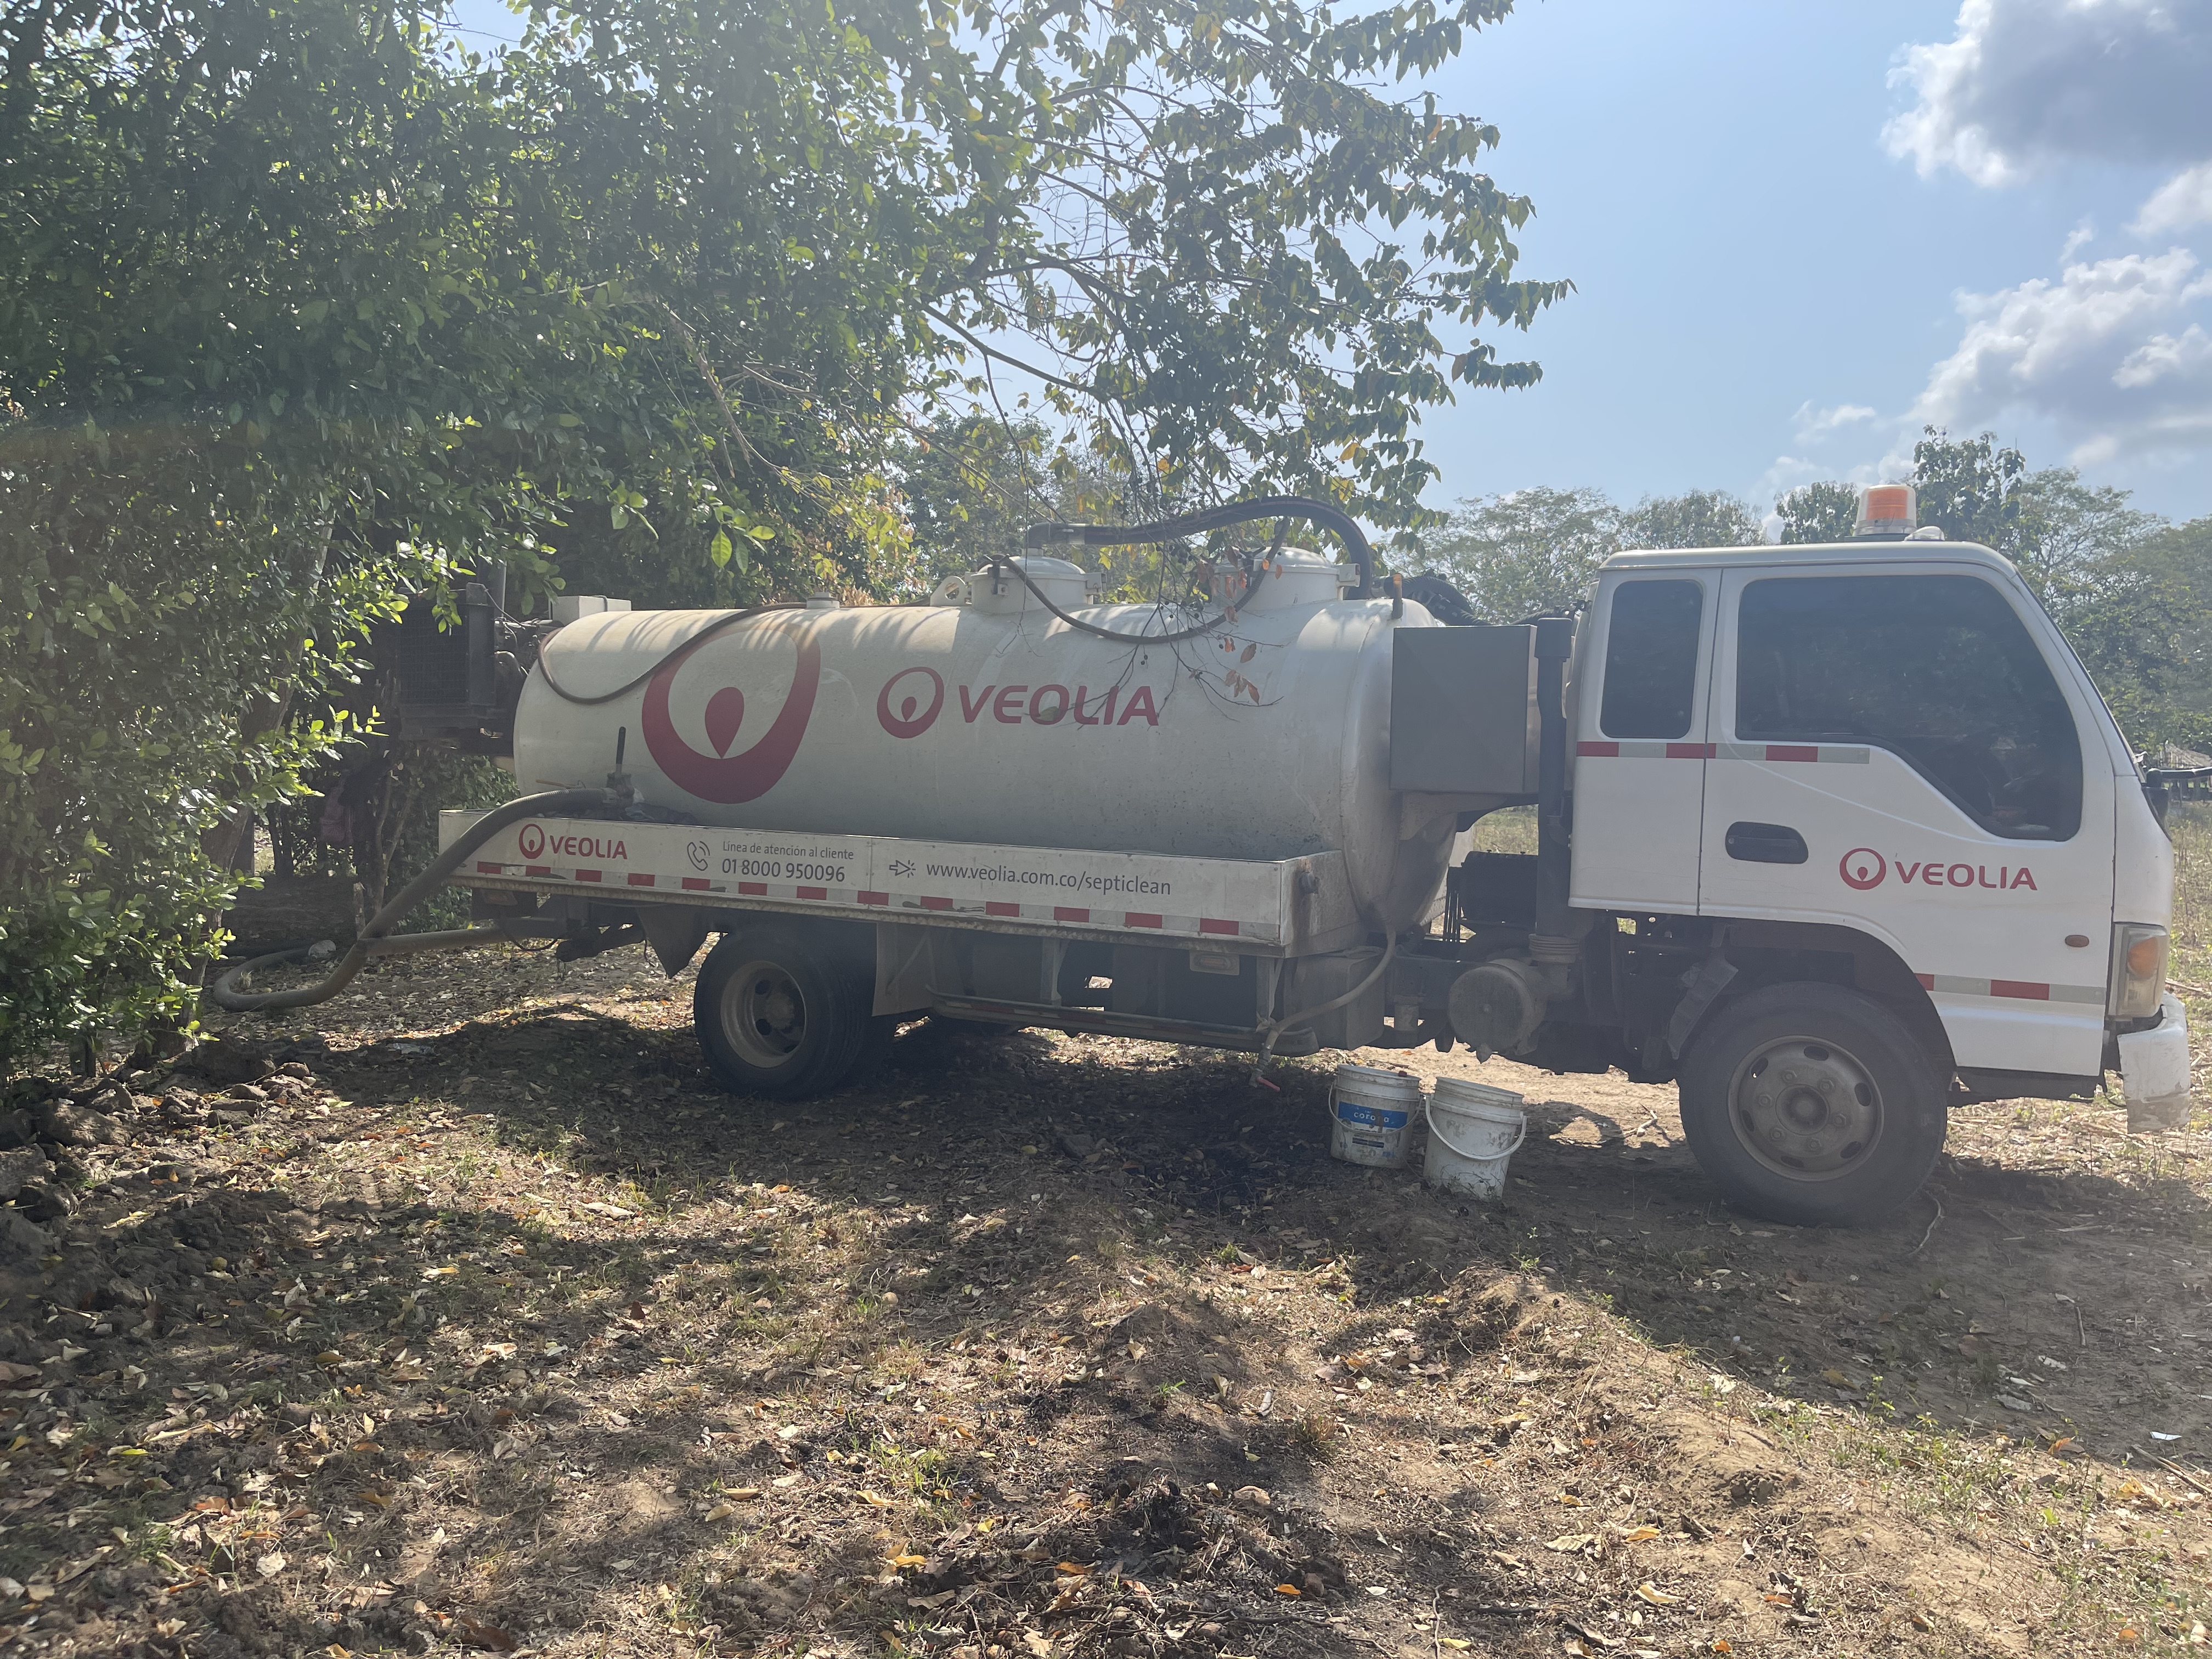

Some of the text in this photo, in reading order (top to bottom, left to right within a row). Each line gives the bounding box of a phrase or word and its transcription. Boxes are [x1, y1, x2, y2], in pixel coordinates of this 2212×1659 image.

[958, 684, 1159, 726] VEOLIA
[550, 835, 628, 860] VEOLIA
[723, 841, 854, 860] Línea de atención al cliente
[722, 858, 845, 882] 01 8000 950096
[927, 862, 1171, 895] www.veolia.com.co/septiclean
[1895, 861, 2038, 890] VEOLIA
[1353, 1112, 1389, 1122] coroa
